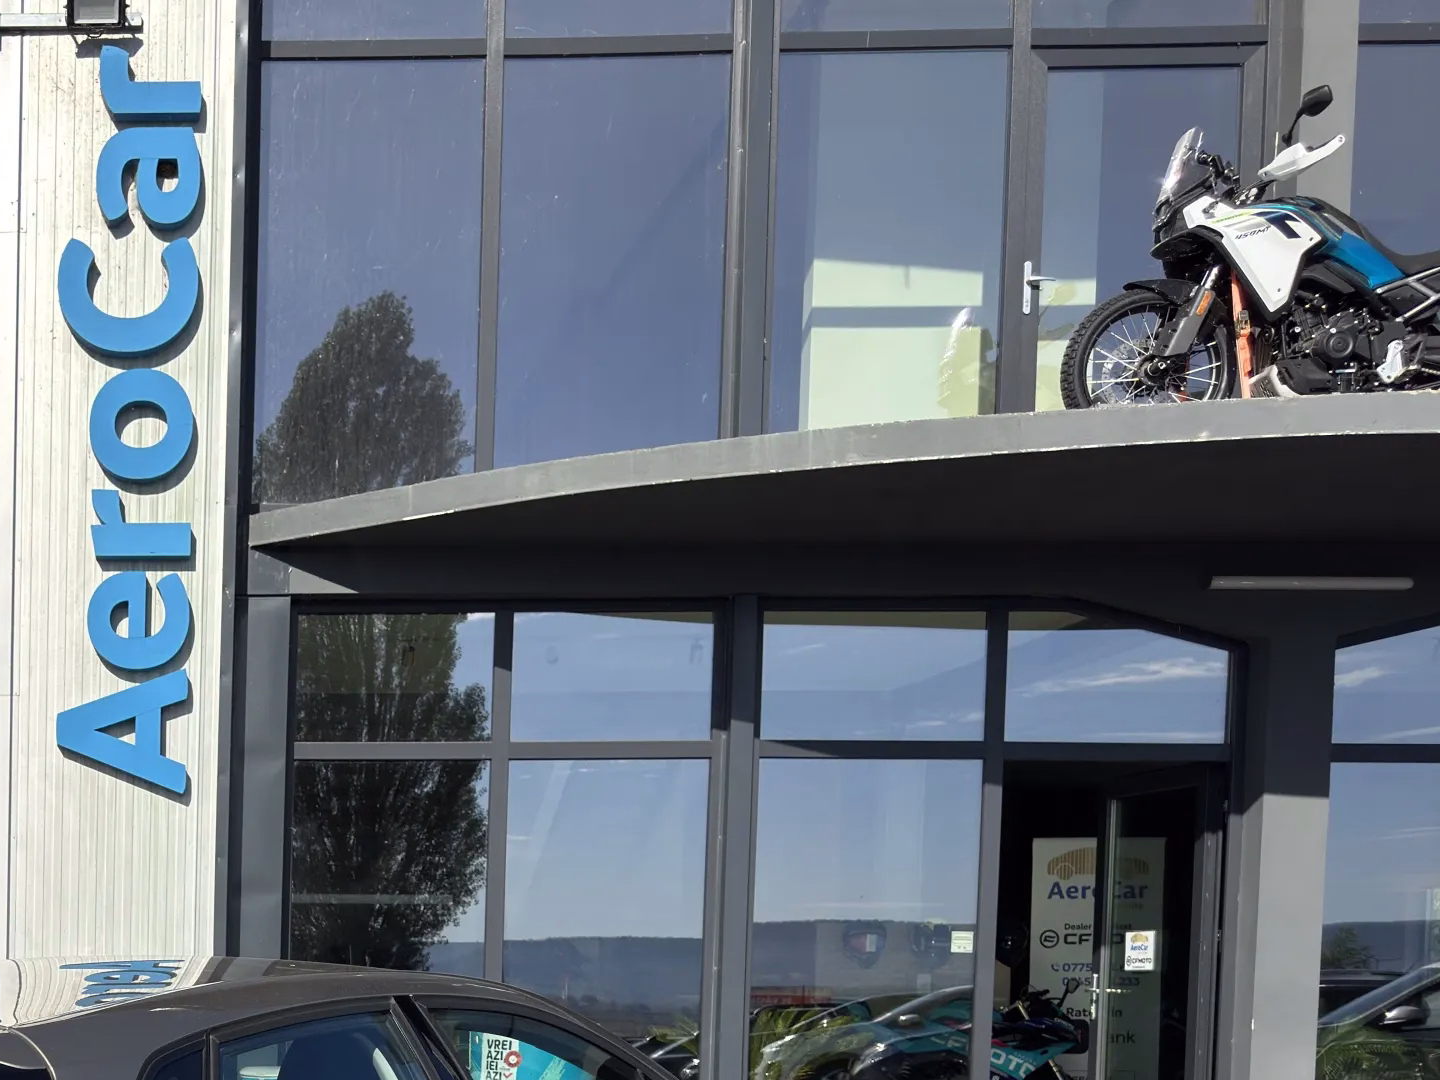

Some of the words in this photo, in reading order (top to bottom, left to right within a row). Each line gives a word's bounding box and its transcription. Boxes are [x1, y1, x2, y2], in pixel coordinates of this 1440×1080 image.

[56, 44, 203, 796] AeroCar
[1064, 923, 1093, 931] Dealer
[486, 1039, 513, 1051] VREI
[486, 1050, 504, 1061] AZI
[486, 1061, 499, 1071] IEI
[486, 1071, 502, 1080] AZI
